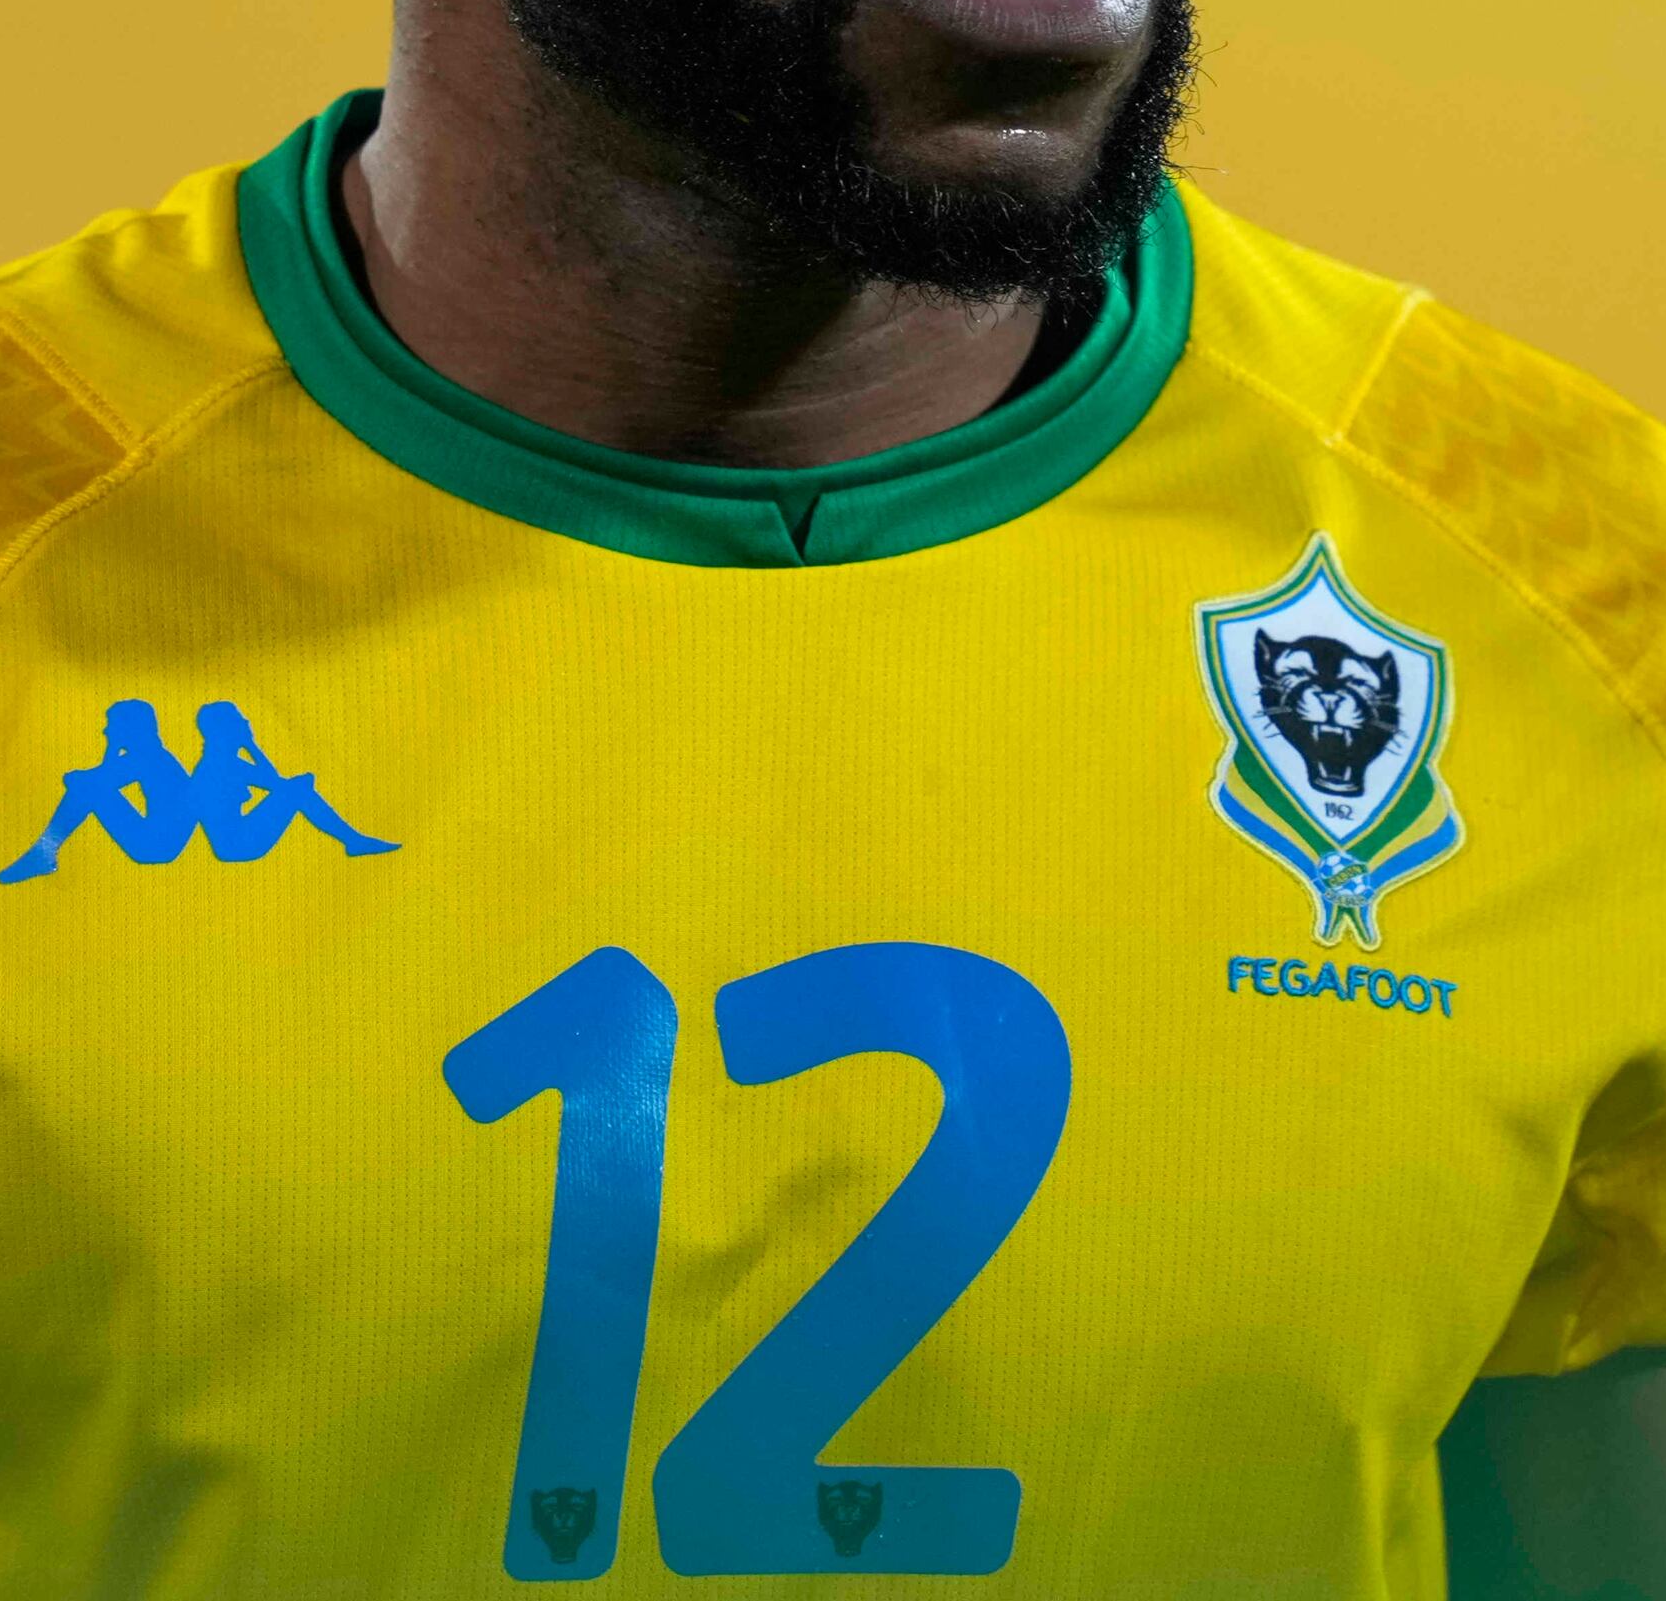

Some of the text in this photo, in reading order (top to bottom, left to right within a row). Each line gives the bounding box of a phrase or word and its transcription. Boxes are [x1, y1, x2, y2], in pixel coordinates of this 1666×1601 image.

[1325, 802, 1354, 820] 1962
[1228, 955, 1457, 1018] FEGAFOOT
[442, 941, 1072, 1581] 12
